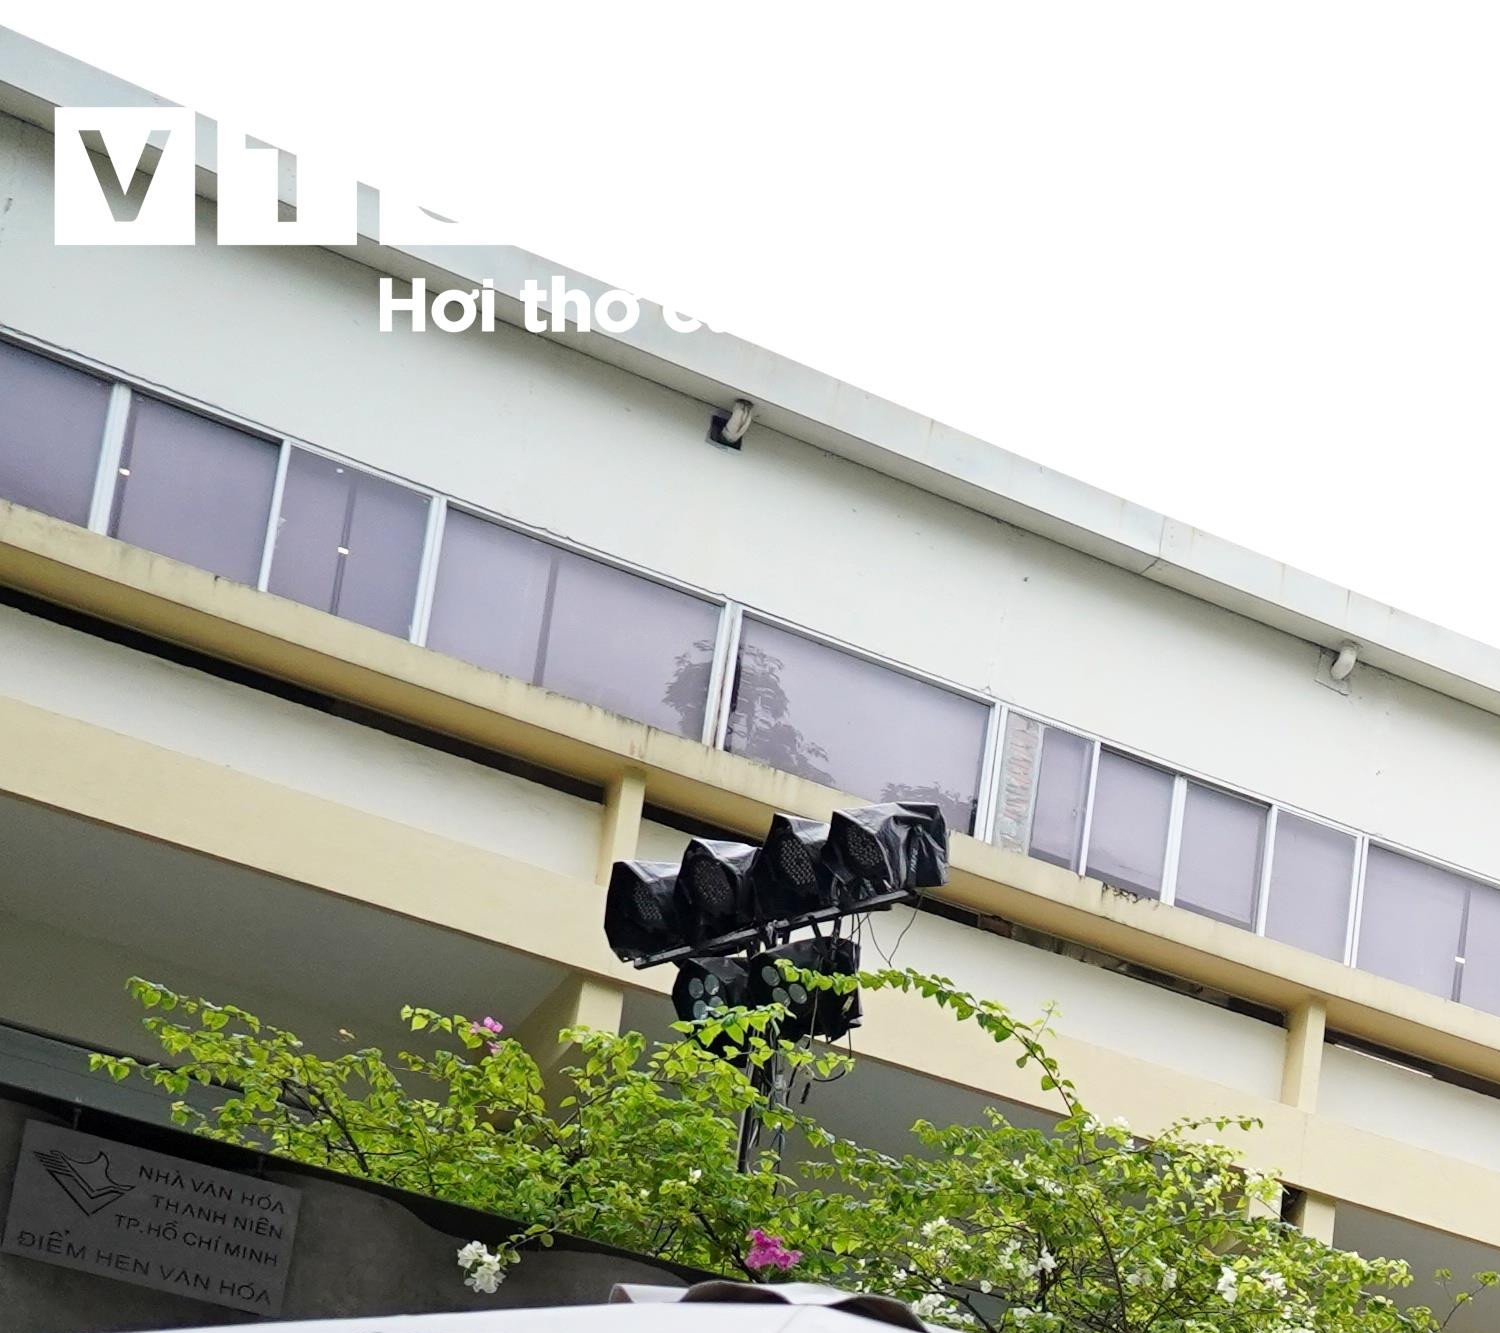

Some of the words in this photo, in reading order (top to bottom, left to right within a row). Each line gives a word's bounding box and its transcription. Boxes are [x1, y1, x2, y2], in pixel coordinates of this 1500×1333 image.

[138, 1165, 185, 1189] NHÀ
[242, 1192, 285, 1215] HÓA
[152, 1194, 228, 1226] THANH
[233, 1216, 284, 1240] NIÊN
[18, 1229, 86, 1261] ĐIỂM
[220, 1280, 271, 1306] HÓA
[183, 1230, 221, 1252] CHÍ
[224, 1241, 278, 1267] MINH
